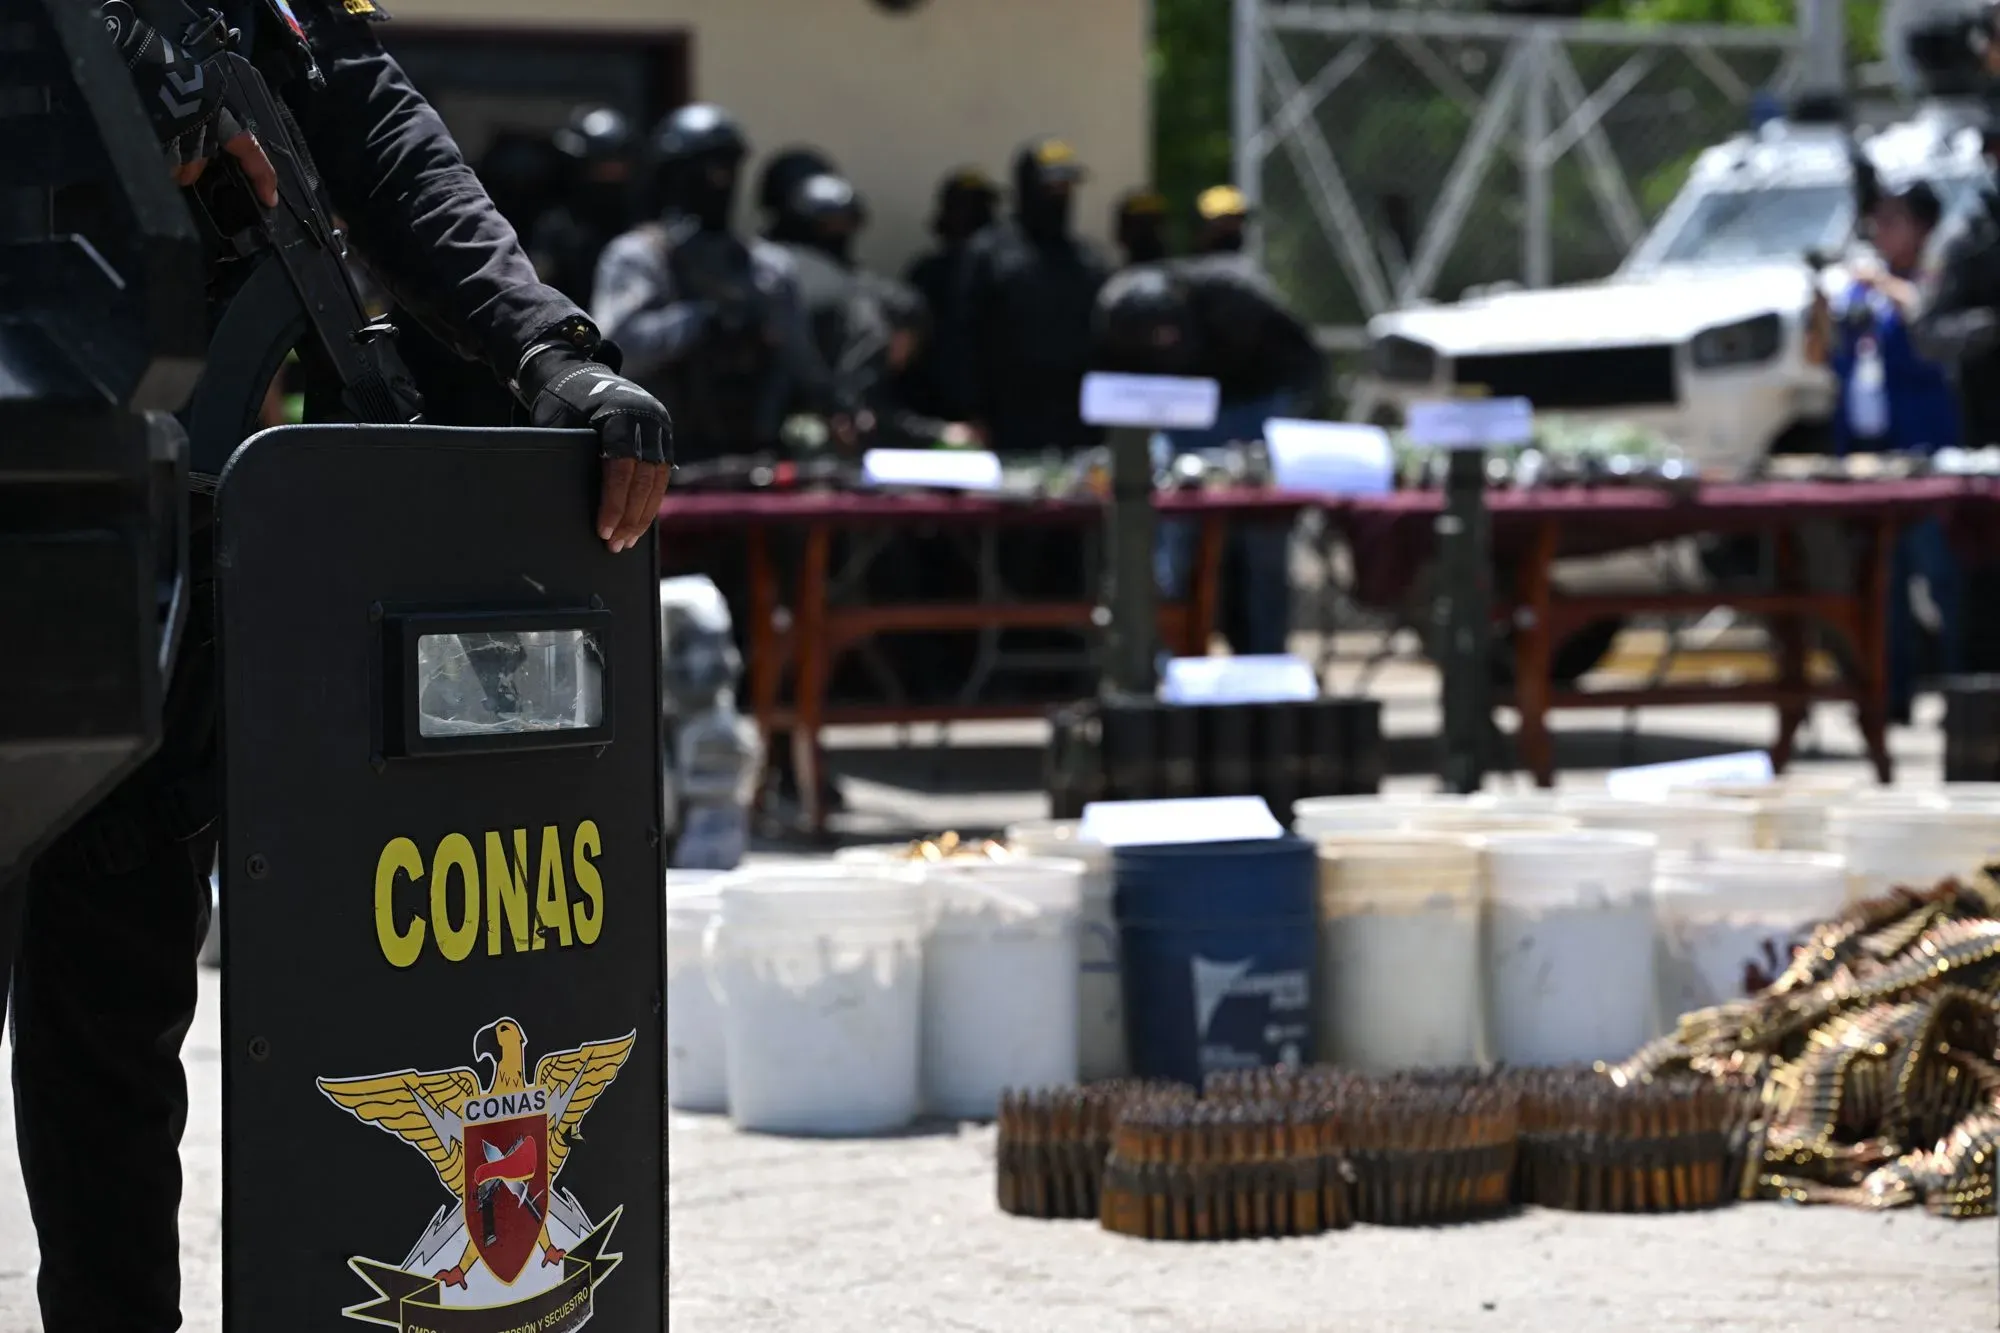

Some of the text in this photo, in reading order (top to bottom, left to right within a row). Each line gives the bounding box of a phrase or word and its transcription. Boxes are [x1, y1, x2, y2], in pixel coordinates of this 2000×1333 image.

[374, 819, 604, 968] CONAS
[465, 1090, 546, 1121] CONAS
[537, 1318, 543, 1332] Y
[544, 1286, 589, 1328] SECUESTRO
